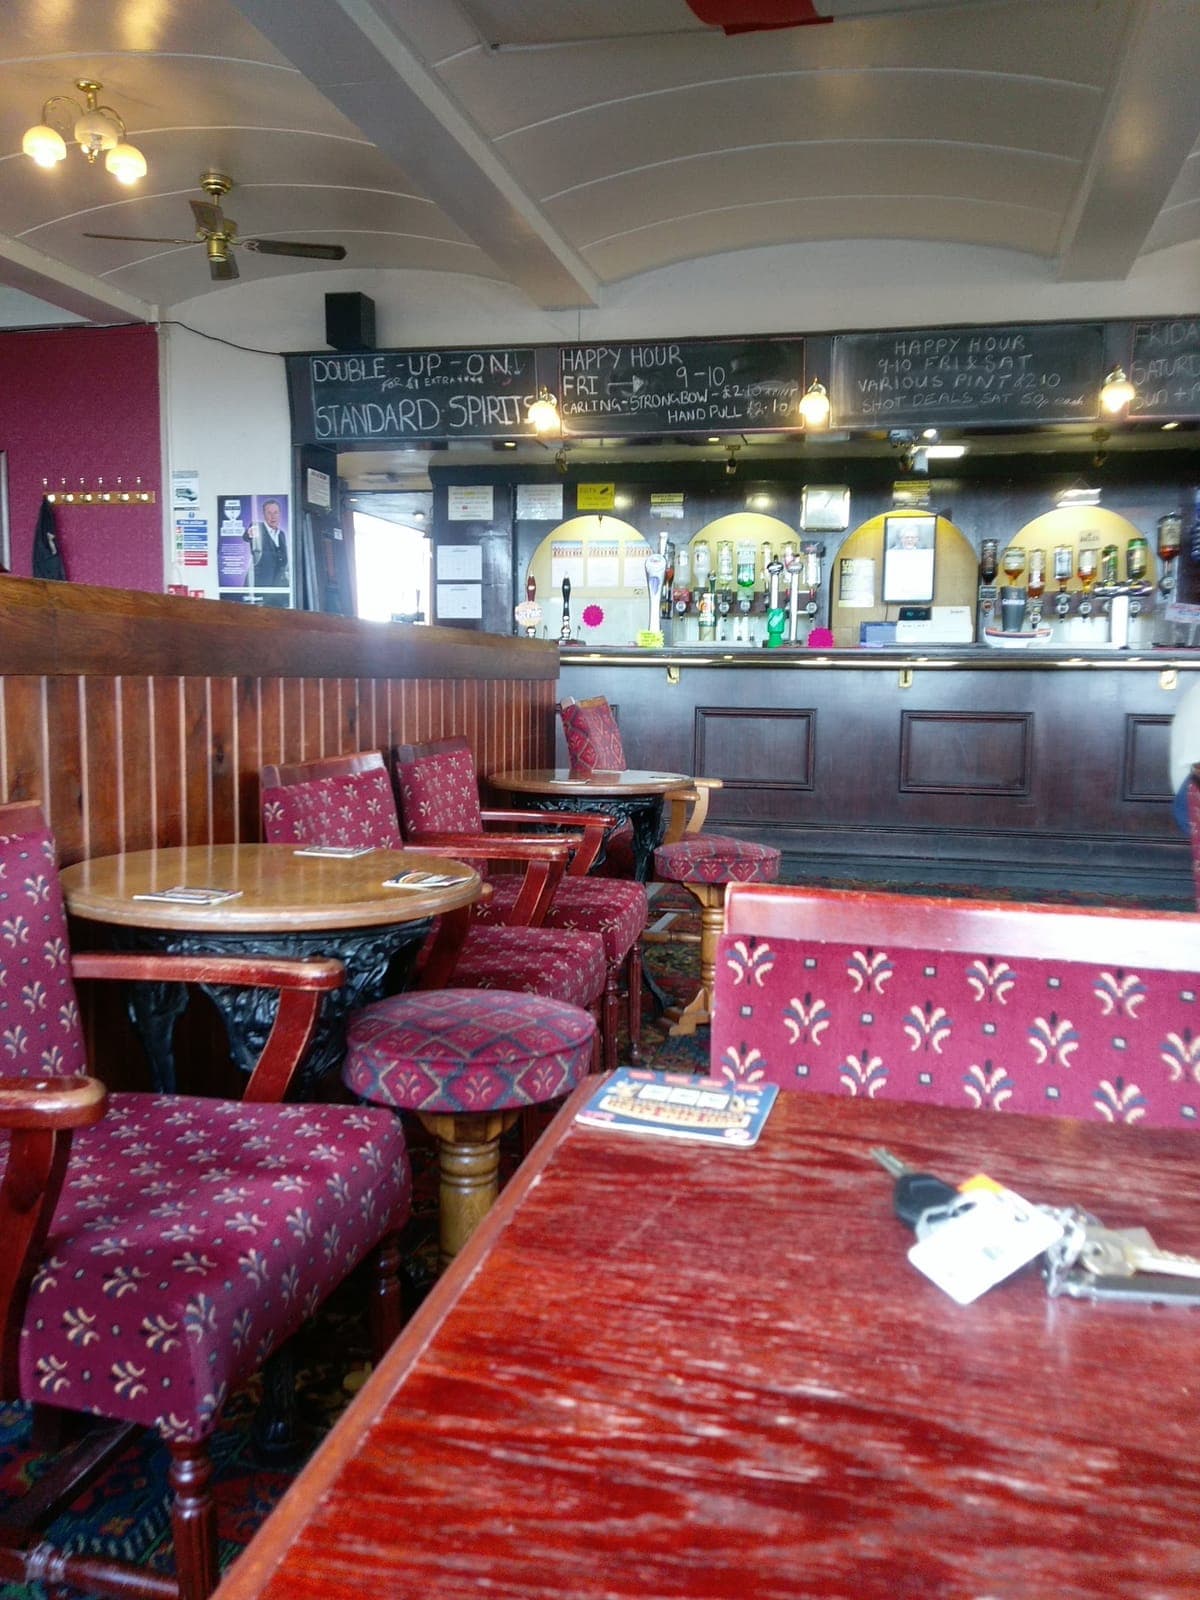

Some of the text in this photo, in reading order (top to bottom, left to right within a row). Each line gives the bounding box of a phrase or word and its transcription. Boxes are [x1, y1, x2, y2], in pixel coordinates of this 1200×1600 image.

[895, 335, 1025, 356] HAPPY HOUR
[562, 345, 683, 371] HAPPY HOUR
[879, 358, 912, 373] 9-10
[925, 355, 959, 371] FRI
[985, 354, 1032, 372] SAT
[312, 357, 386, 382] DOUBLE
[381, 377, 403, 392] FOR
[562, 375, 599, 396] FRI
[858, 376, 944, 392] VARIOUS
[953, 373, 1012, 390] PINT
[862, 396, 907, 413] SHOT
[912, 391, 974, 408] DEALS
[316, 399, 441, 437] STANDARD
[667, 407, 706, 424] HAND
[709, 404, 742, 418] PULL
